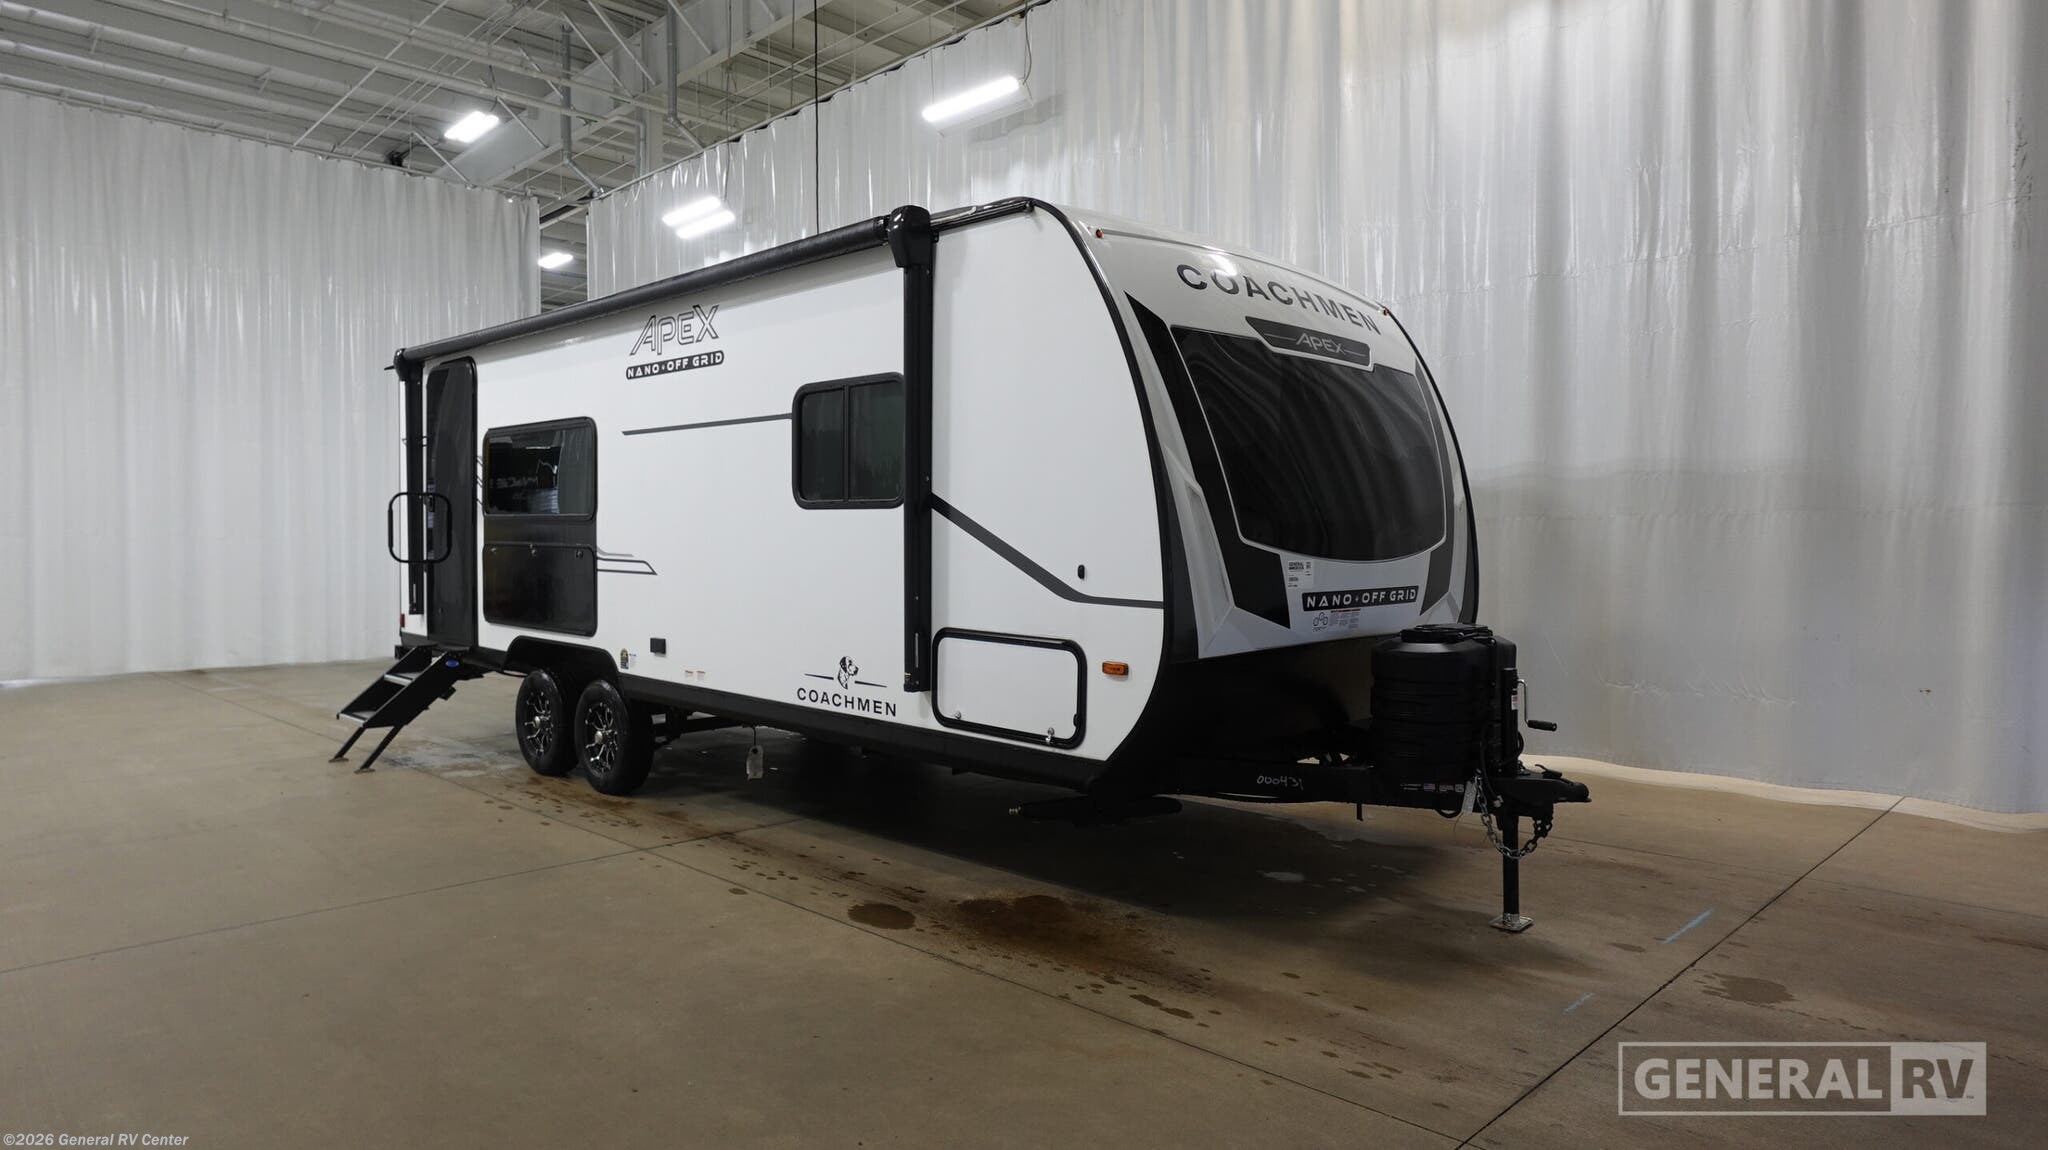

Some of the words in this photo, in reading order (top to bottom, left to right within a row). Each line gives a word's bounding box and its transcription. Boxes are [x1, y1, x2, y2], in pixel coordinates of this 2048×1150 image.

[1176, 264, 1381, 335] COACHMEN
[630, 304, 719, 355] APEX
[1296, 332, 1345, 355] APEX
[667, 358, 689, 371] OFF
[693, 353, 722, 367] GRID
[1362, 590, 1386, 604] OFF
[1389, 589, 1416, 602] GRID
[797, 687, 897, 717] COACHMEN
